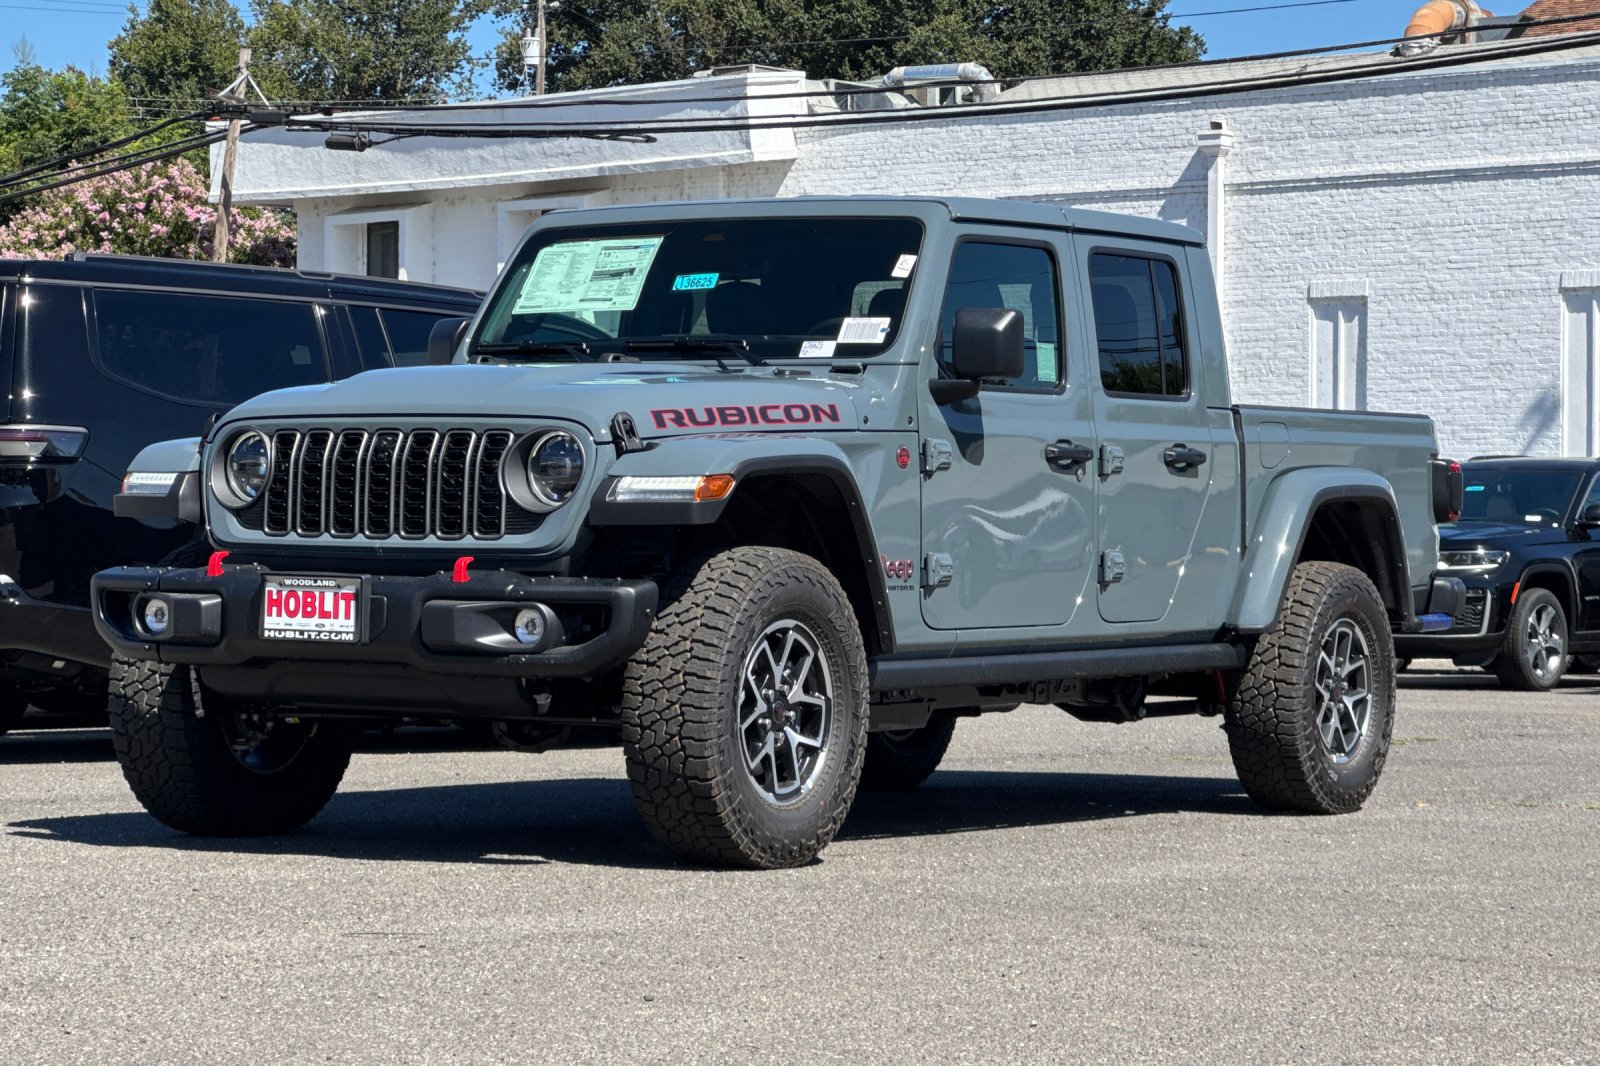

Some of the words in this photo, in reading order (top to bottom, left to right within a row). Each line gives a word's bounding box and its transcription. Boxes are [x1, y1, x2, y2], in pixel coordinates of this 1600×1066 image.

[649, 403, 841, 429] RUBICON
[284, 578, 336, 587] WOODLAND
[266, 589, 356, 620] HOBLIT
[264, 630, 354, 641] HOBLIT.COM
